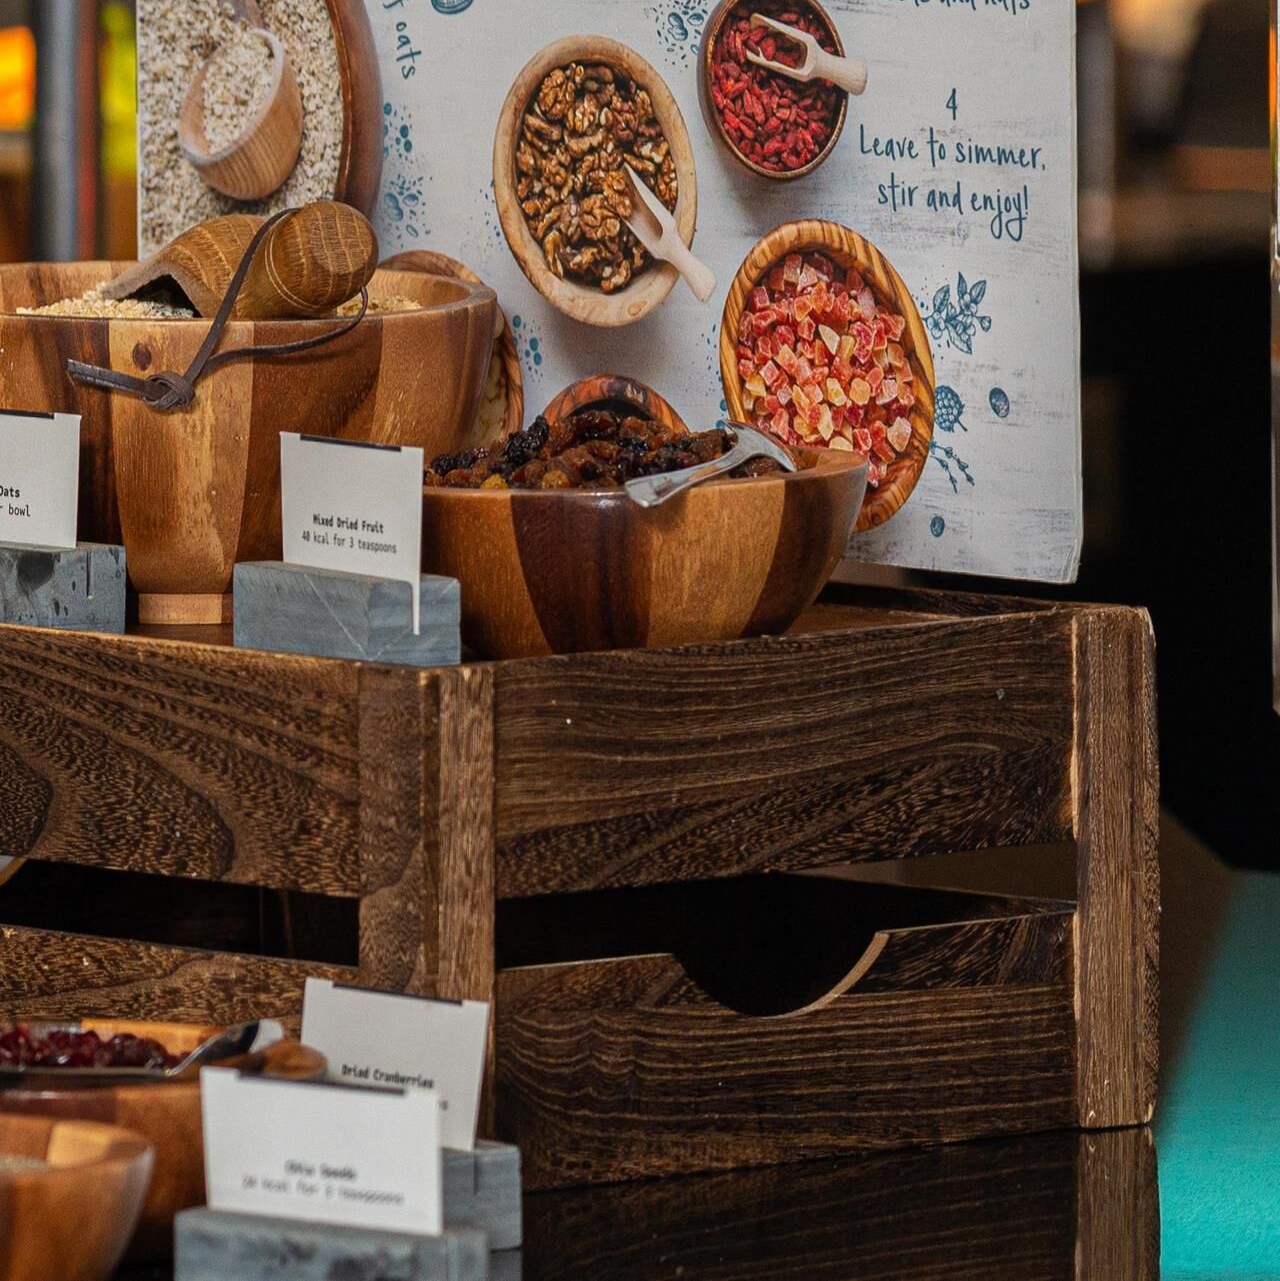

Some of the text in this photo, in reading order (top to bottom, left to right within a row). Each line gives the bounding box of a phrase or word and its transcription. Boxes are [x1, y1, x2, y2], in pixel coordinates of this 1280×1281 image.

[396, 21, 422, 80] oats
[946, 88, 958, 120] 4
[860, 124, 919, 161] Leave
[926, 127, 945, 168] to
[878, 172, 1029, 241] stir and enjoy!
[8, 504, 31, 517] bowl
[313, 513, 384, 534] Mixed Dried Fruit
[313, 531, 329, 545] kcal
[334, 533, 345, 546] for
[350, 536, 354, 548] 3
[358, 539, 397, 554] teaspoons
[341, 1064, 434, 1089] Dried Cranberries
